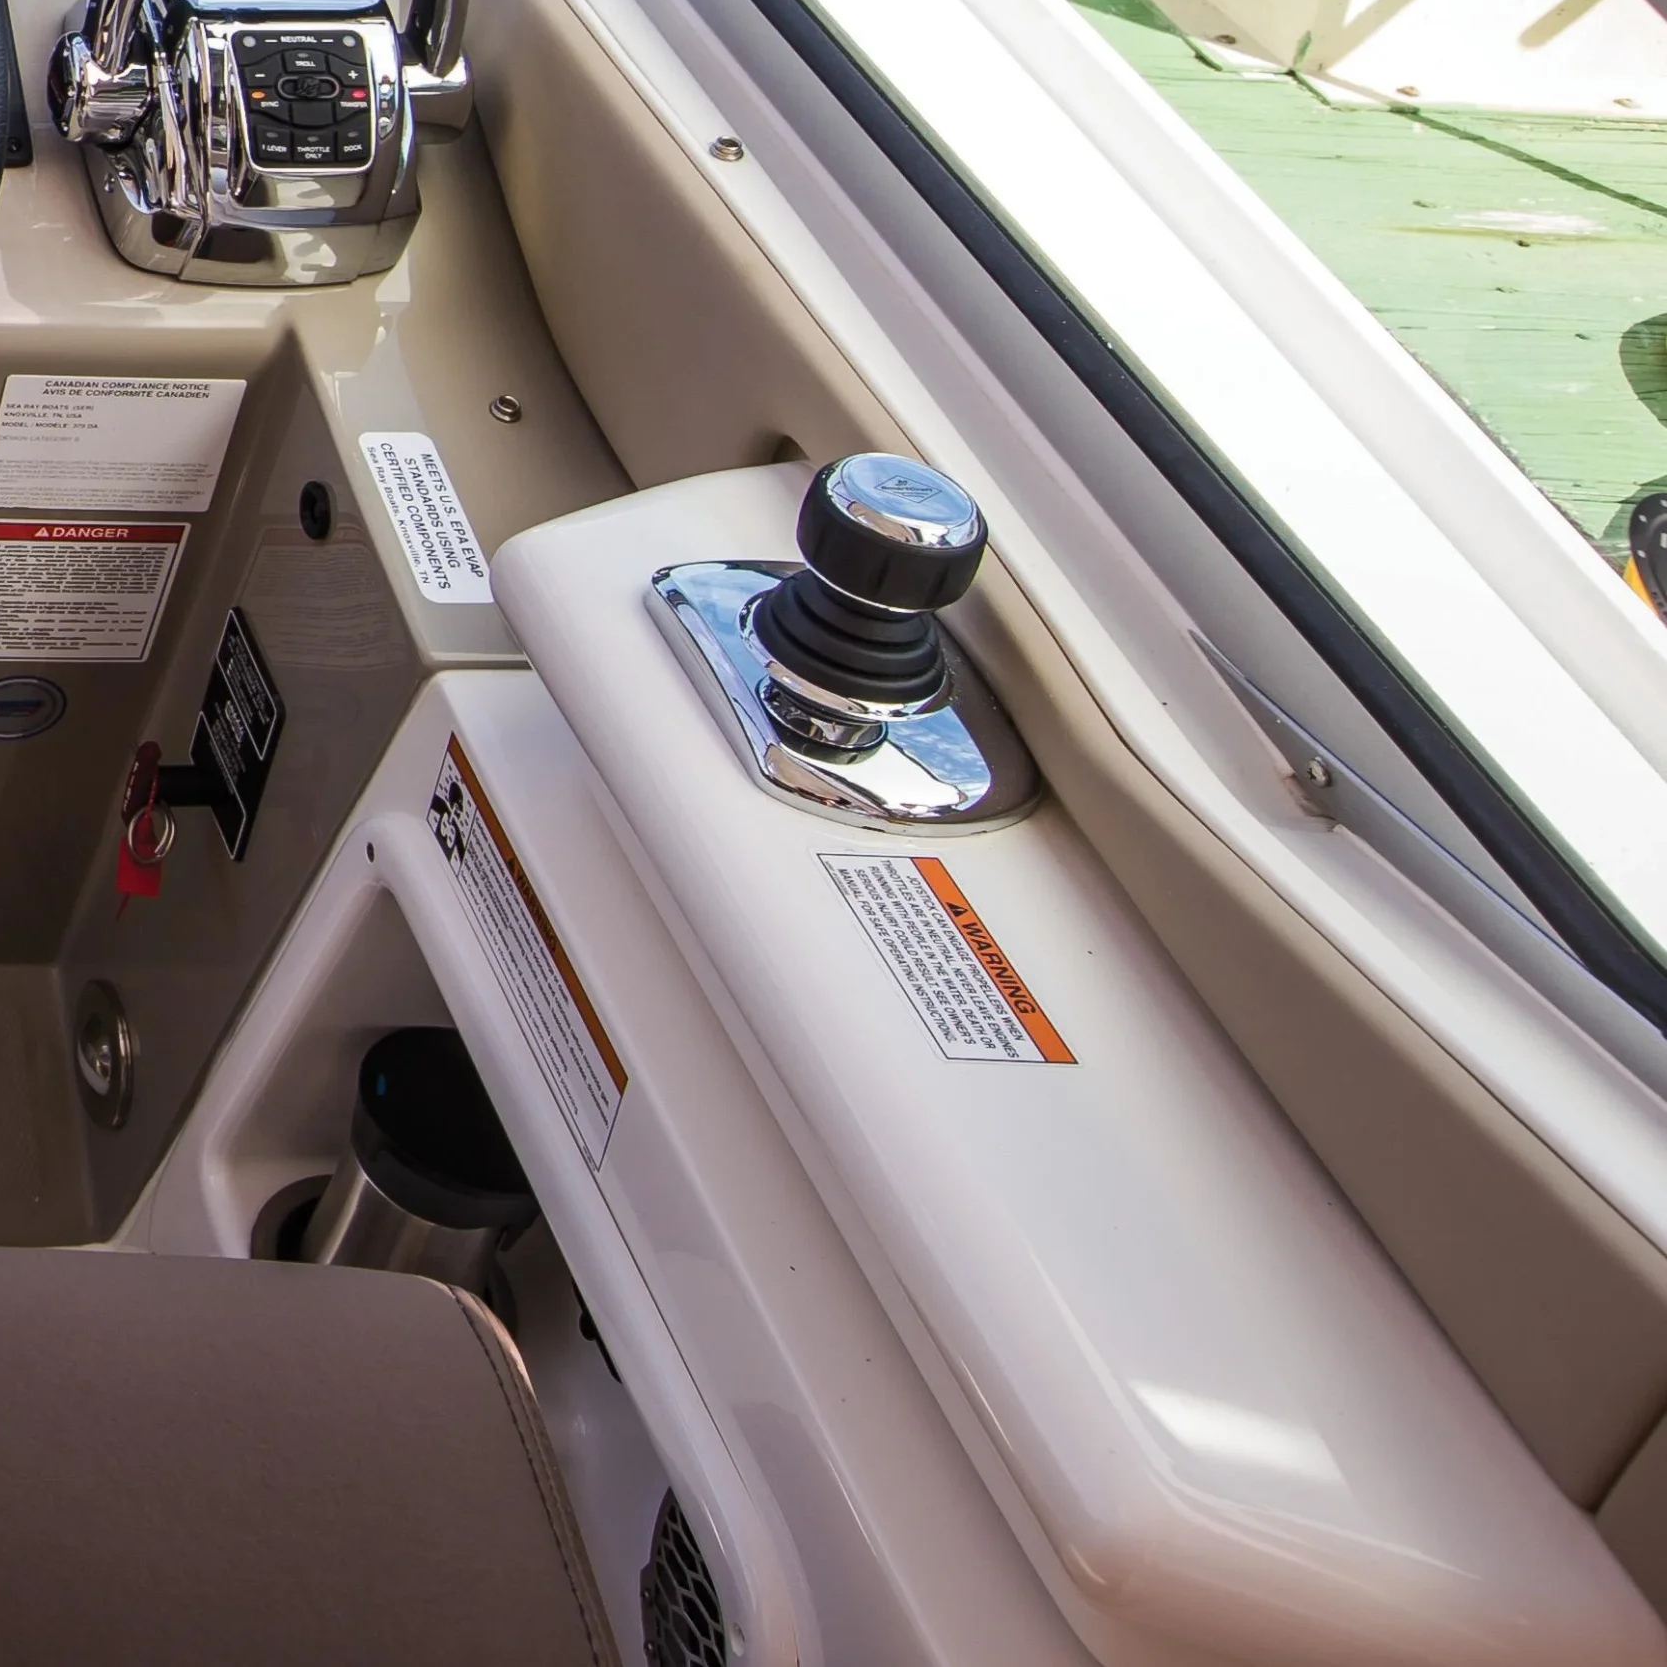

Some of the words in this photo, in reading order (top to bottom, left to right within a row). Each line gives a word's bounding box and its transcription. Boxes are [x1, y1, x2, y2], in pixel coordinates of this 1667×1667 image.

[45, 380, 99, 388] CANADIAN
[102, 382, 170, 390] COMPLIANCE
[172, 383, 211, 391] NOTICE
[156, 391, 210, 399] CANADIEN
[52, 527, 129, 538] DANGER
[367, 446, 378, 464] Sea
[375, 466, 387, 484] Ray
[419, 570, 431, 584] TN
[381, 442, 414, 502] CERTIFIED
[407, 506, 451, 589] COMPONENTS
[404, 458, 443, 528] STANDARDS
[436, 531, 461, 569] USING
[421, 453, 447, 492] MEETS
[440, 496, 457, 517] U.S.
[451, 520, 469, 544] EPA
[462, 548, 484, 578] EVAP
[837, 868, 864, 899] MANUAL
[858, 901, 876, 916] FOR
[869, 917, 890, 937] SAFE
[883, 938, 919, 982] OPERATING
[911, 983, 957, 1044] INSTRUCTIONS.
[854, 869, 883, 901] SERIOUS
[875, 902, 901, 929] INJURY
[894, 930, 919, 957] COULD
[933, 990, 950, 1006] SEE
[944, 1008, 976, 1045] OWNER'S
[868, 866, 897, 899] RUNNING
[891, 901, 910, 919] WITH
[904, 920, 932, 950] PEOPLE
[924, 950, 937, 961] IN
[931, 961, 947, 977] THE
[961, 1008, 985, 1038] DEATH
[980, 1038, 996, 1049] OR
[880, 860, 915, 901] THROTTLES
[910, 903, 927, 918] ARE
[919, 920, 933, 929] IN
[952, 968, 975, 998] NEVER
[970, 996, 994, 1021] LEAVE
[988, 1022, 1019, 1059] ENGINES
[907, 875, 939, 911] JOYSTICK
[931, 912, 950, 932] CAN
[943, 930, 971, 964] ENGAGE
[967, 963, 1008, 1015] PROPELLERS
[1001, 1017, 1025, 1041] WHEN
[961, 922, 1036, 1014] WARNING
